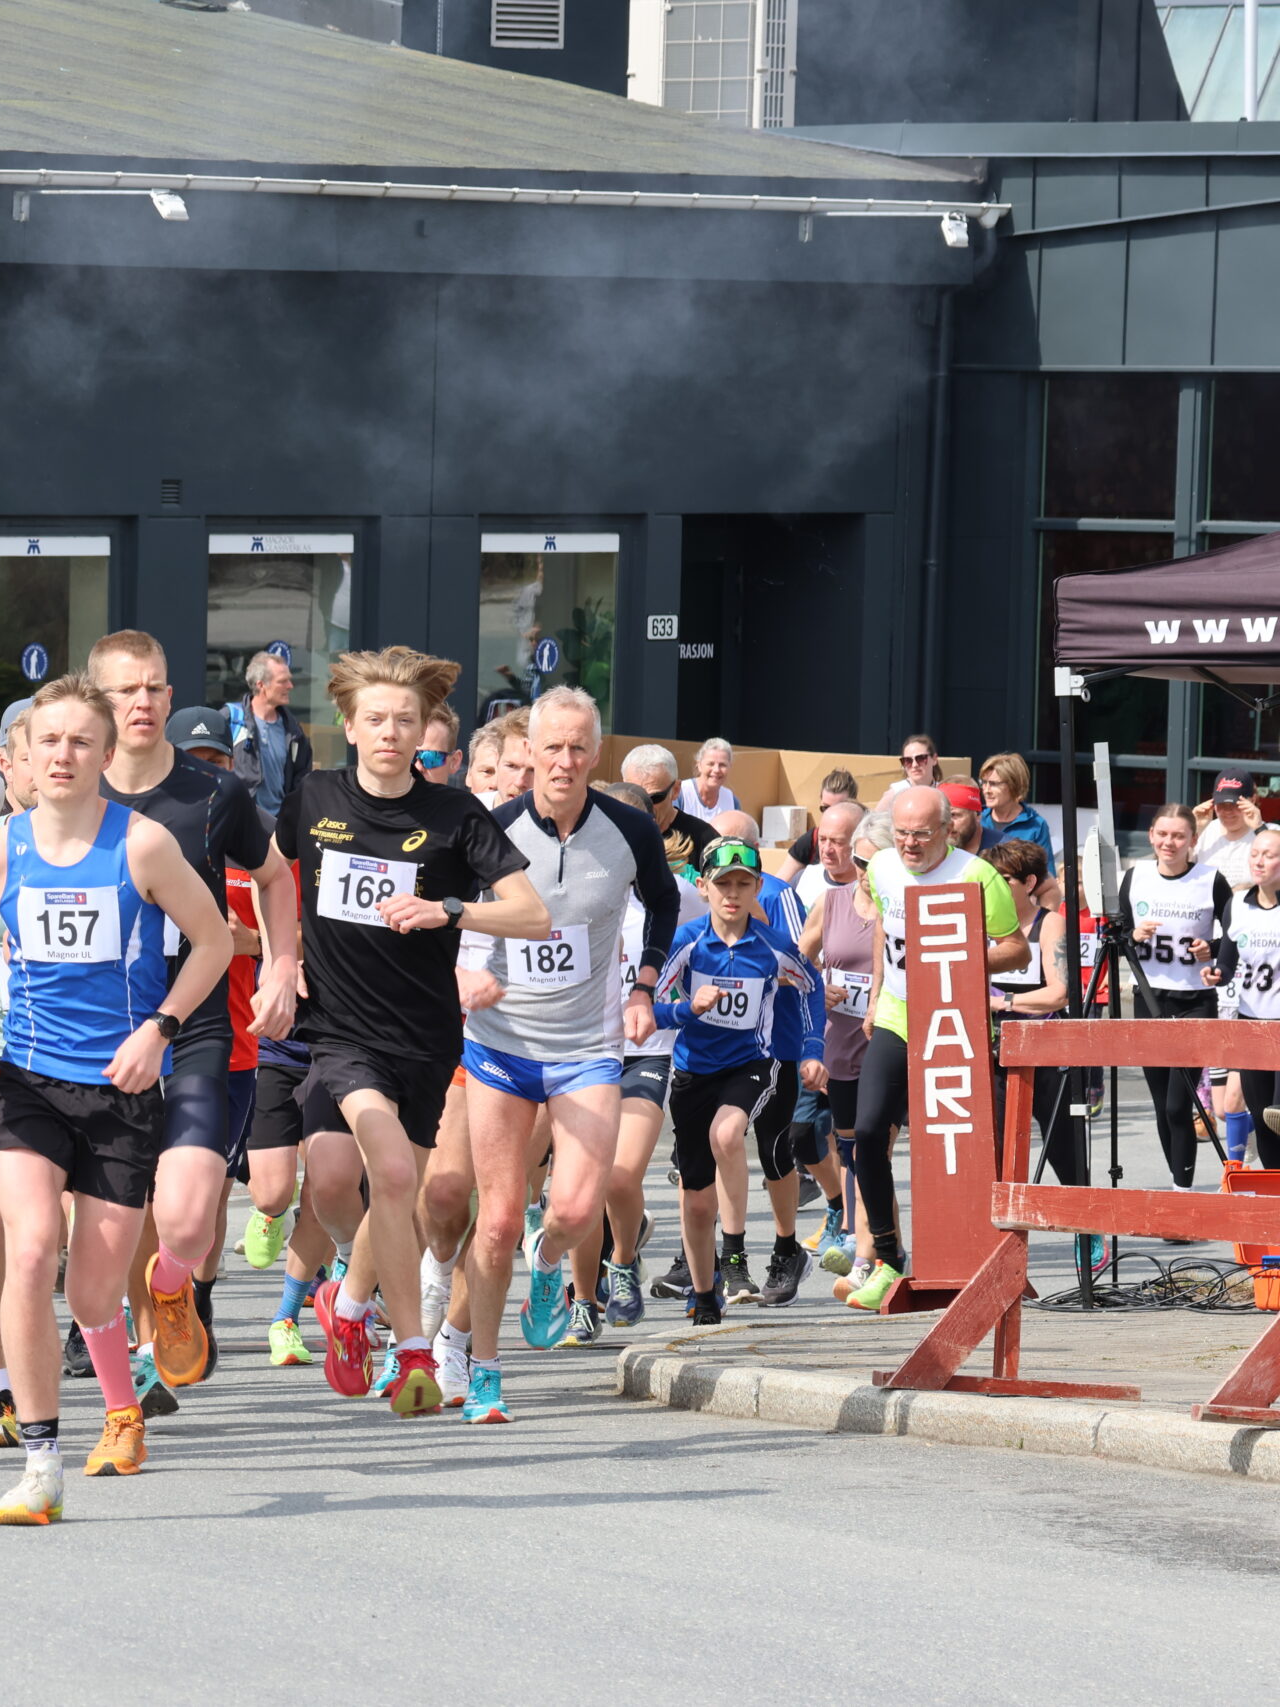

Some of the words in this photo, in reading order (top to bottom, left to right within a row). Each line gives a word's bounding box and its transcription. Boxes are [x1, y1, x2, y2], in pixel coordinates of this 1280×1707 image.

[652, 618, 673, 637] 633
[679, 643, 714, 660] RASJON
[338, 873, 396, 909] 168
[341, 909, 371, 920] Magnor
[1150, 908, 1202, 921] HEDMARK
[36, 909, 100, 947] 157
[47, 950, 80, 960] Magnor
[81, 951, 93, 959] UL
[520, 942, 575, 974] 182
[529, 975, 557, 984] Magnor
[706, 991, 749, 1018] 09
[706, 1015, 730, 1025] Magnor
[918, 892, 976, 1176] START
